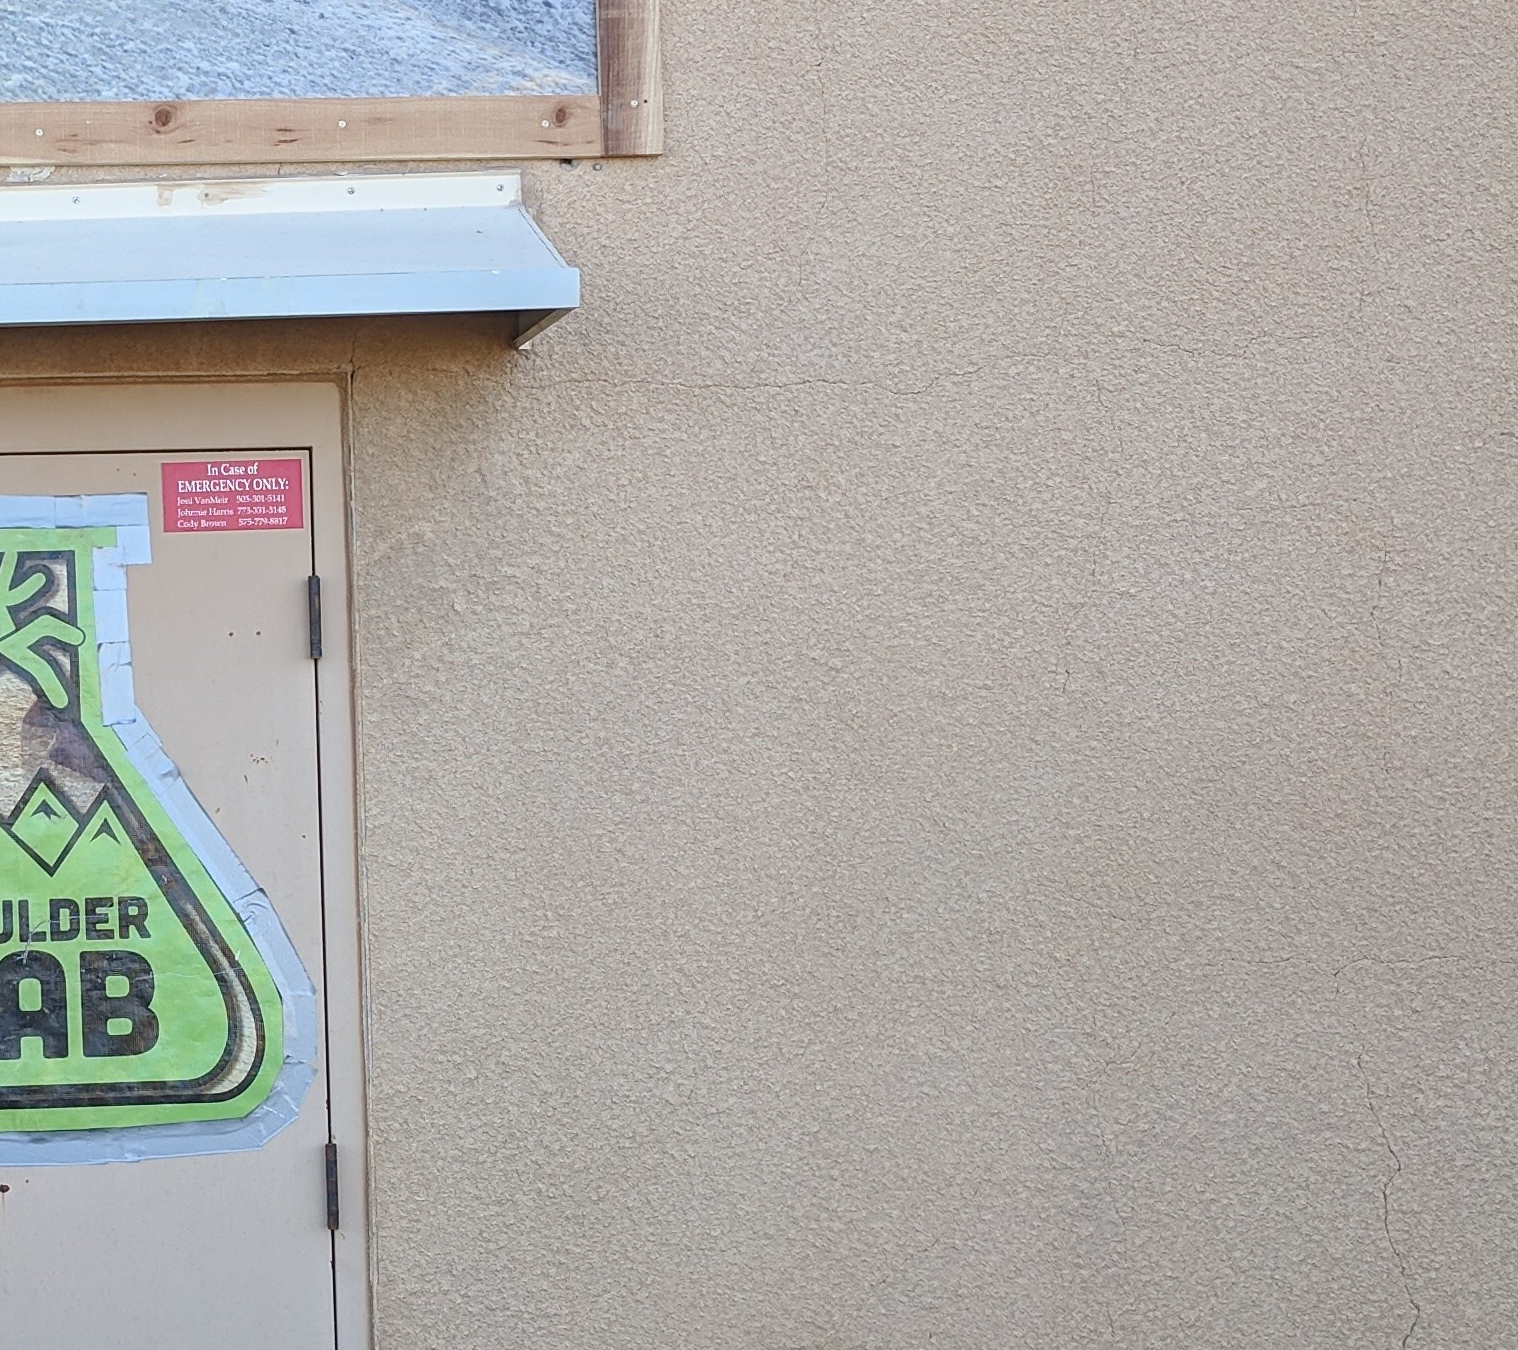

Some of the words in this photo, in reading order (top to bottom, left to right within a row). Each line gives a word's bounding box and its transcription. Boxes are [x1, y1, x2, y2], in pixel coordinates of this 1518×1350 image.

[207, 463, 218, 476] In
[221, 463, 245, 476] Case
[248, 462, 259, 475] of
[178, 479, 250, 493] EMERGENCY
[253, 478, 289, 491] ONLY:
